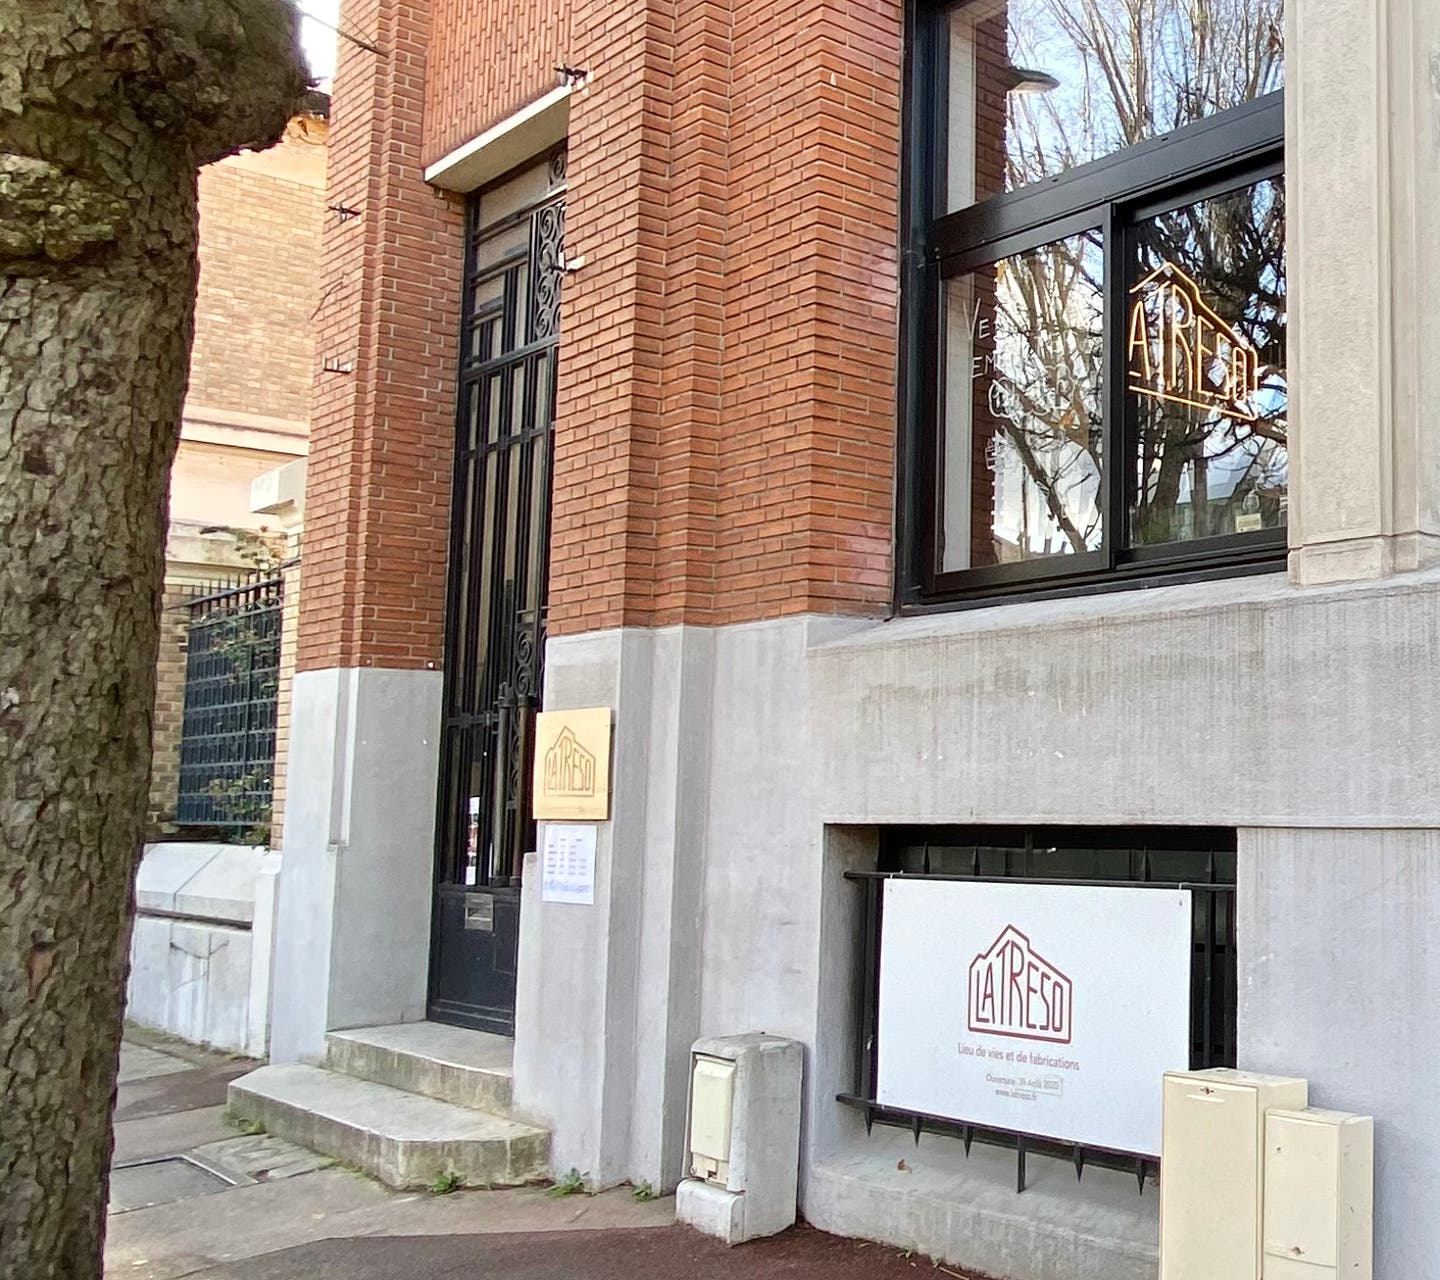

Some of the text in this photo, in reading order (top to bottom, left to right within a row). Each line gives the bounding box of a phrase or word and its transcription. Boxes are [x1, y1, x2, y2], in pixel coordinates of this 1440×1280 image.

[996, 938, 1063, 1032] TRESO
[957, 1041, 1080, 1070] Lieu de vies et de fabrications
